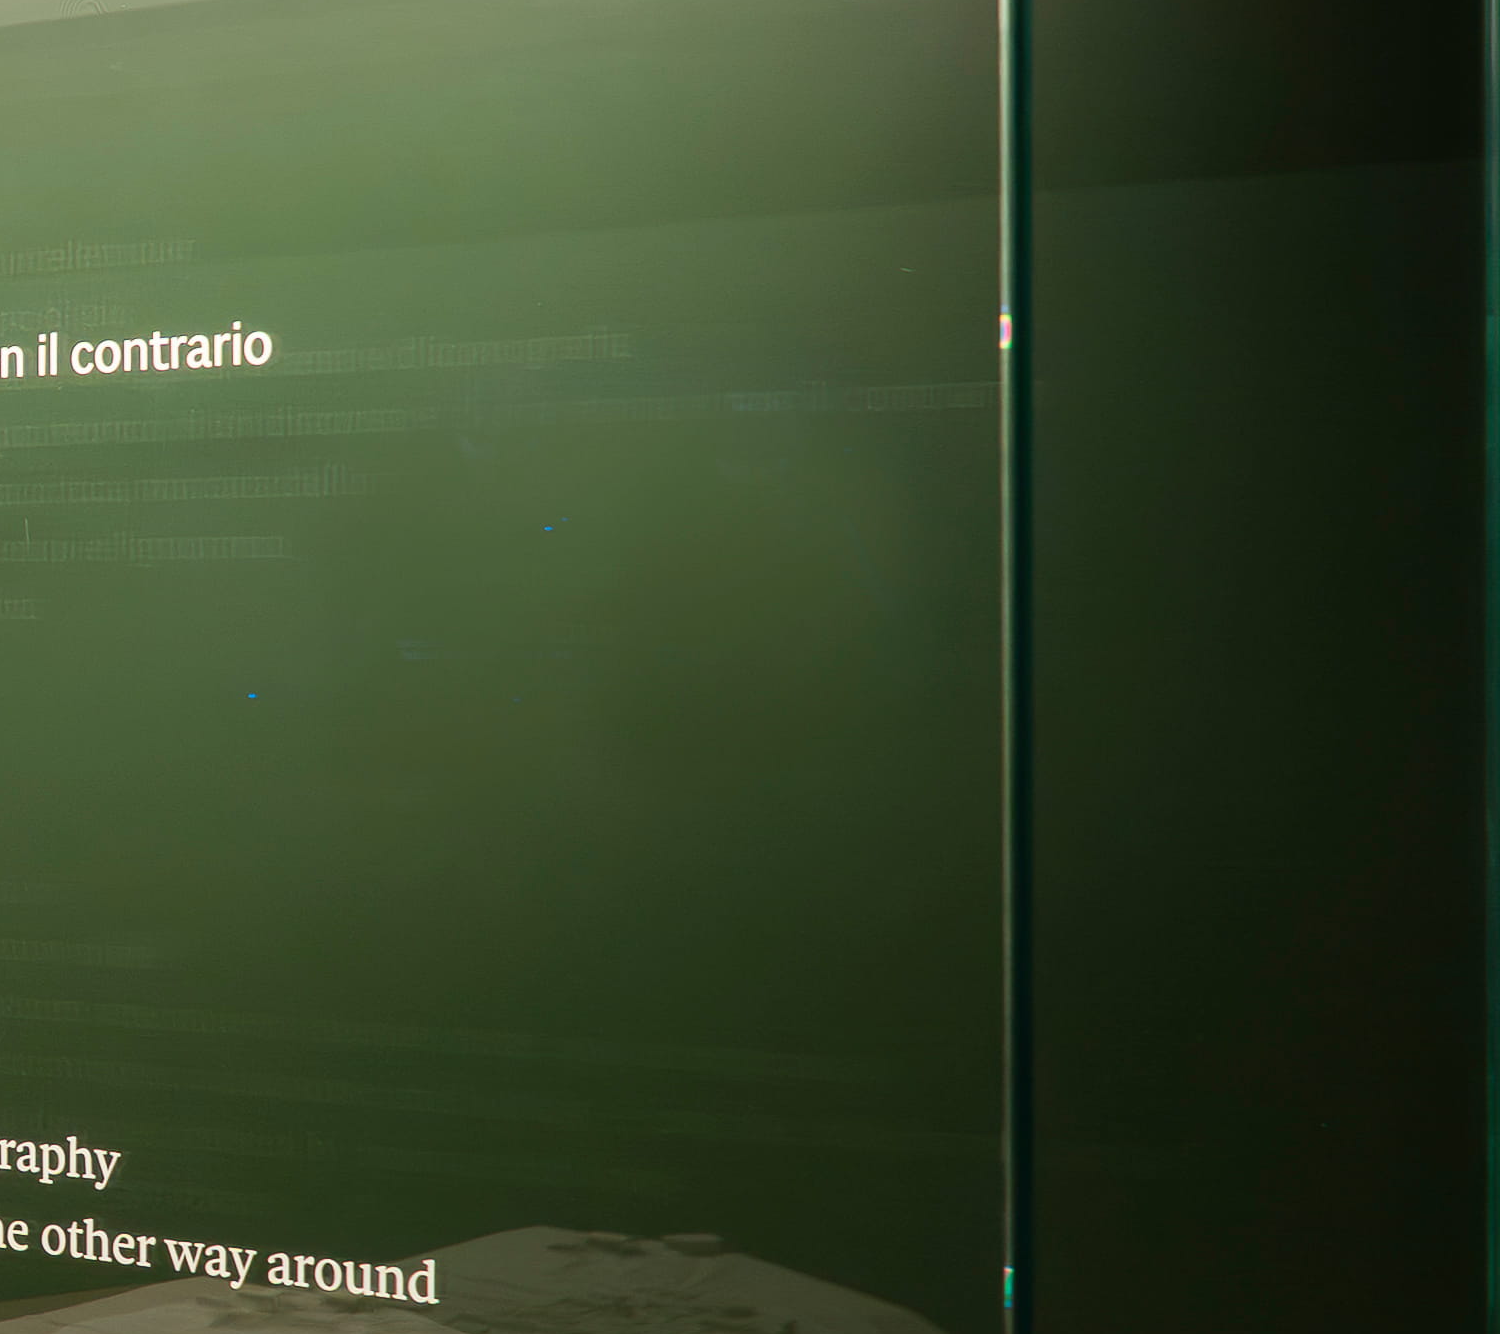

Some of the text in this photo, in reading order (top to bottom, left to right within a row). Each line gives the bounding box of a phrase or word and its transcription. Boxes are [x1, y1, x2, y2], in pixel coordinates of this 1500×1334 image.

[37, 331, 58, 377] il
[71, 320, 273, 375] contrario
[41, 1217, 157, 1268] other
[163, 1238, 258, 1290] way
[267, 1252, 440, 1305] around
